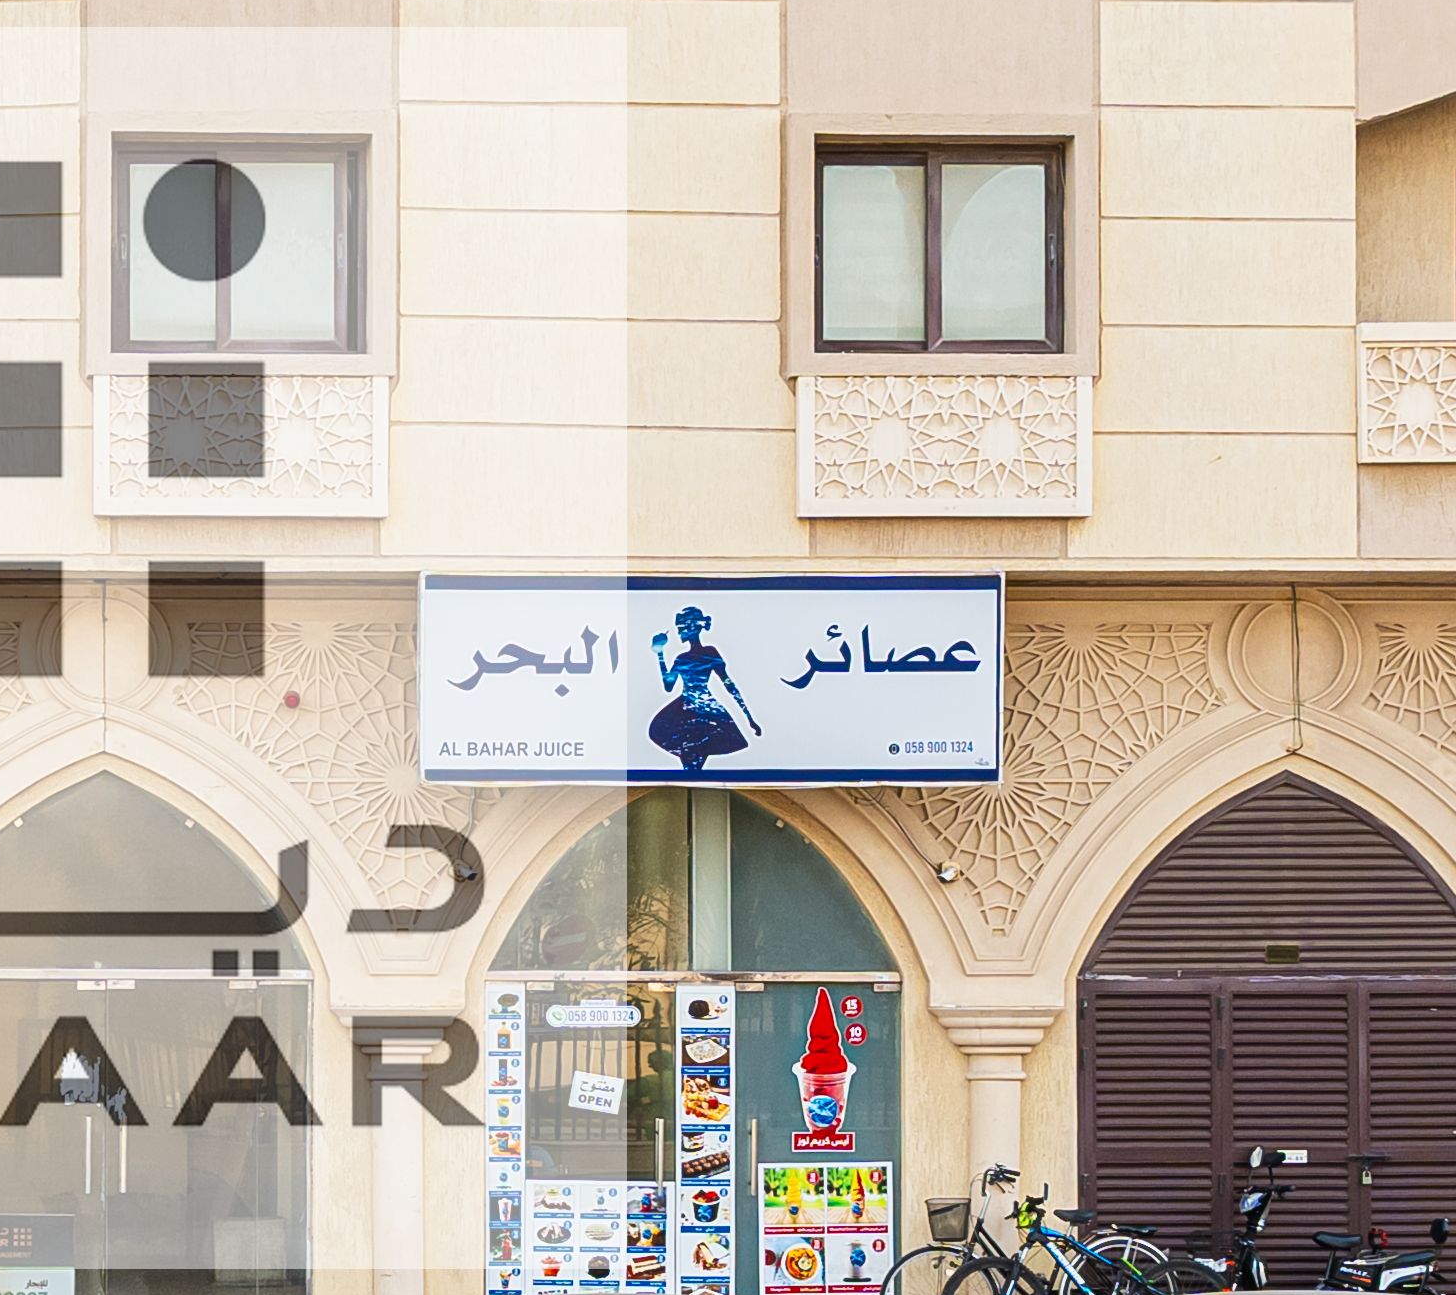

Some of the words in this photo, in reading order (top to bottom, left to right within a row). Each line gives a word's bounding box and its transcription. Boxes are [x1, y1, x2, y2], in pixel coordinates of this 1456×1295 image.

[446, 625, 620, 697] البحر
[779, 624, 981, 690] عصائر
[439, 742, 462, 756] AL
[467, 742, 529, 757] BAHAR
[533, 742, 585, 757] JUICE
[904, 741, 925, 753] 058
[927, 741, 947, 753] 900
[950, 740, 974, 753] 1324
[844, 999, 858, 1010] 15
[568, 1010, 587, 1022] 058
[589, 1010, 609, 1022] 900
[612, 1011, 634, 1022] 1324
[849, 1026, 863, 1038] 10
[579, 1080, 615, 1093] مفتوح
[578, 1094, 613, 1108] OPEN
